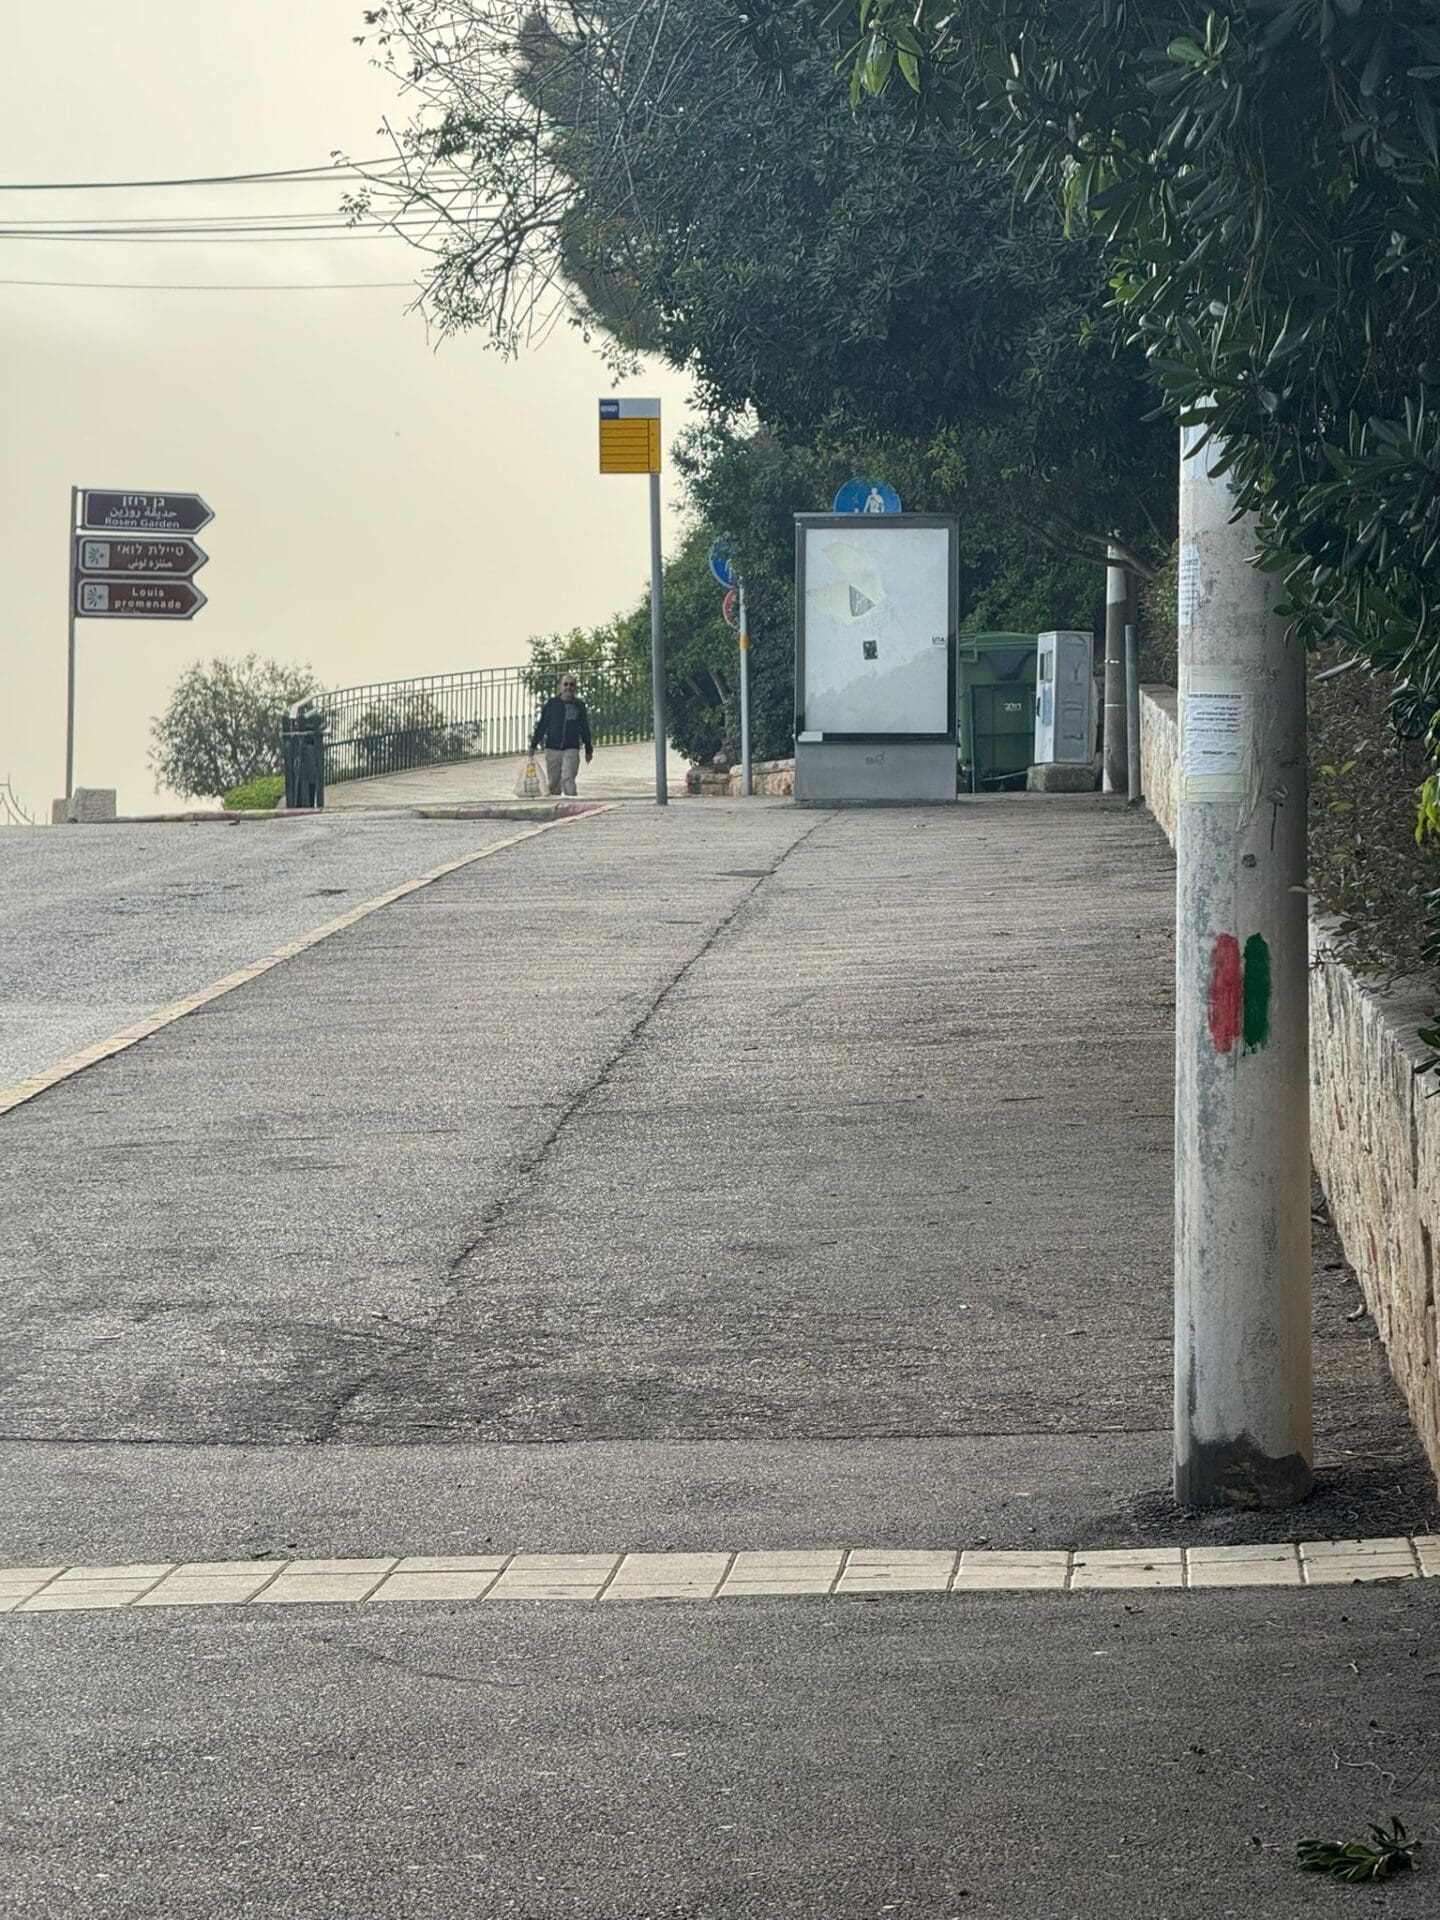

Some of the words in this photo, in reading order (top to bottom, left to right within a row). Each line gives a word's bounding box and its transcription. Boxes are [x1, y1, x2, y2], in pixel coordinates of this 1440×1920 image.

[122, 495, 147, 507] רוזן
[153, 496, 165, 508] גן
[105, 516, 137, 526] Rosen
[140, 518, 180, 529] Garden
[117, 543, 143, 555] לואי
[148, 544, 184, 556] טיילת
[132, 587, 164, 597] Louis
[114, 599, 182, 609] promenade
